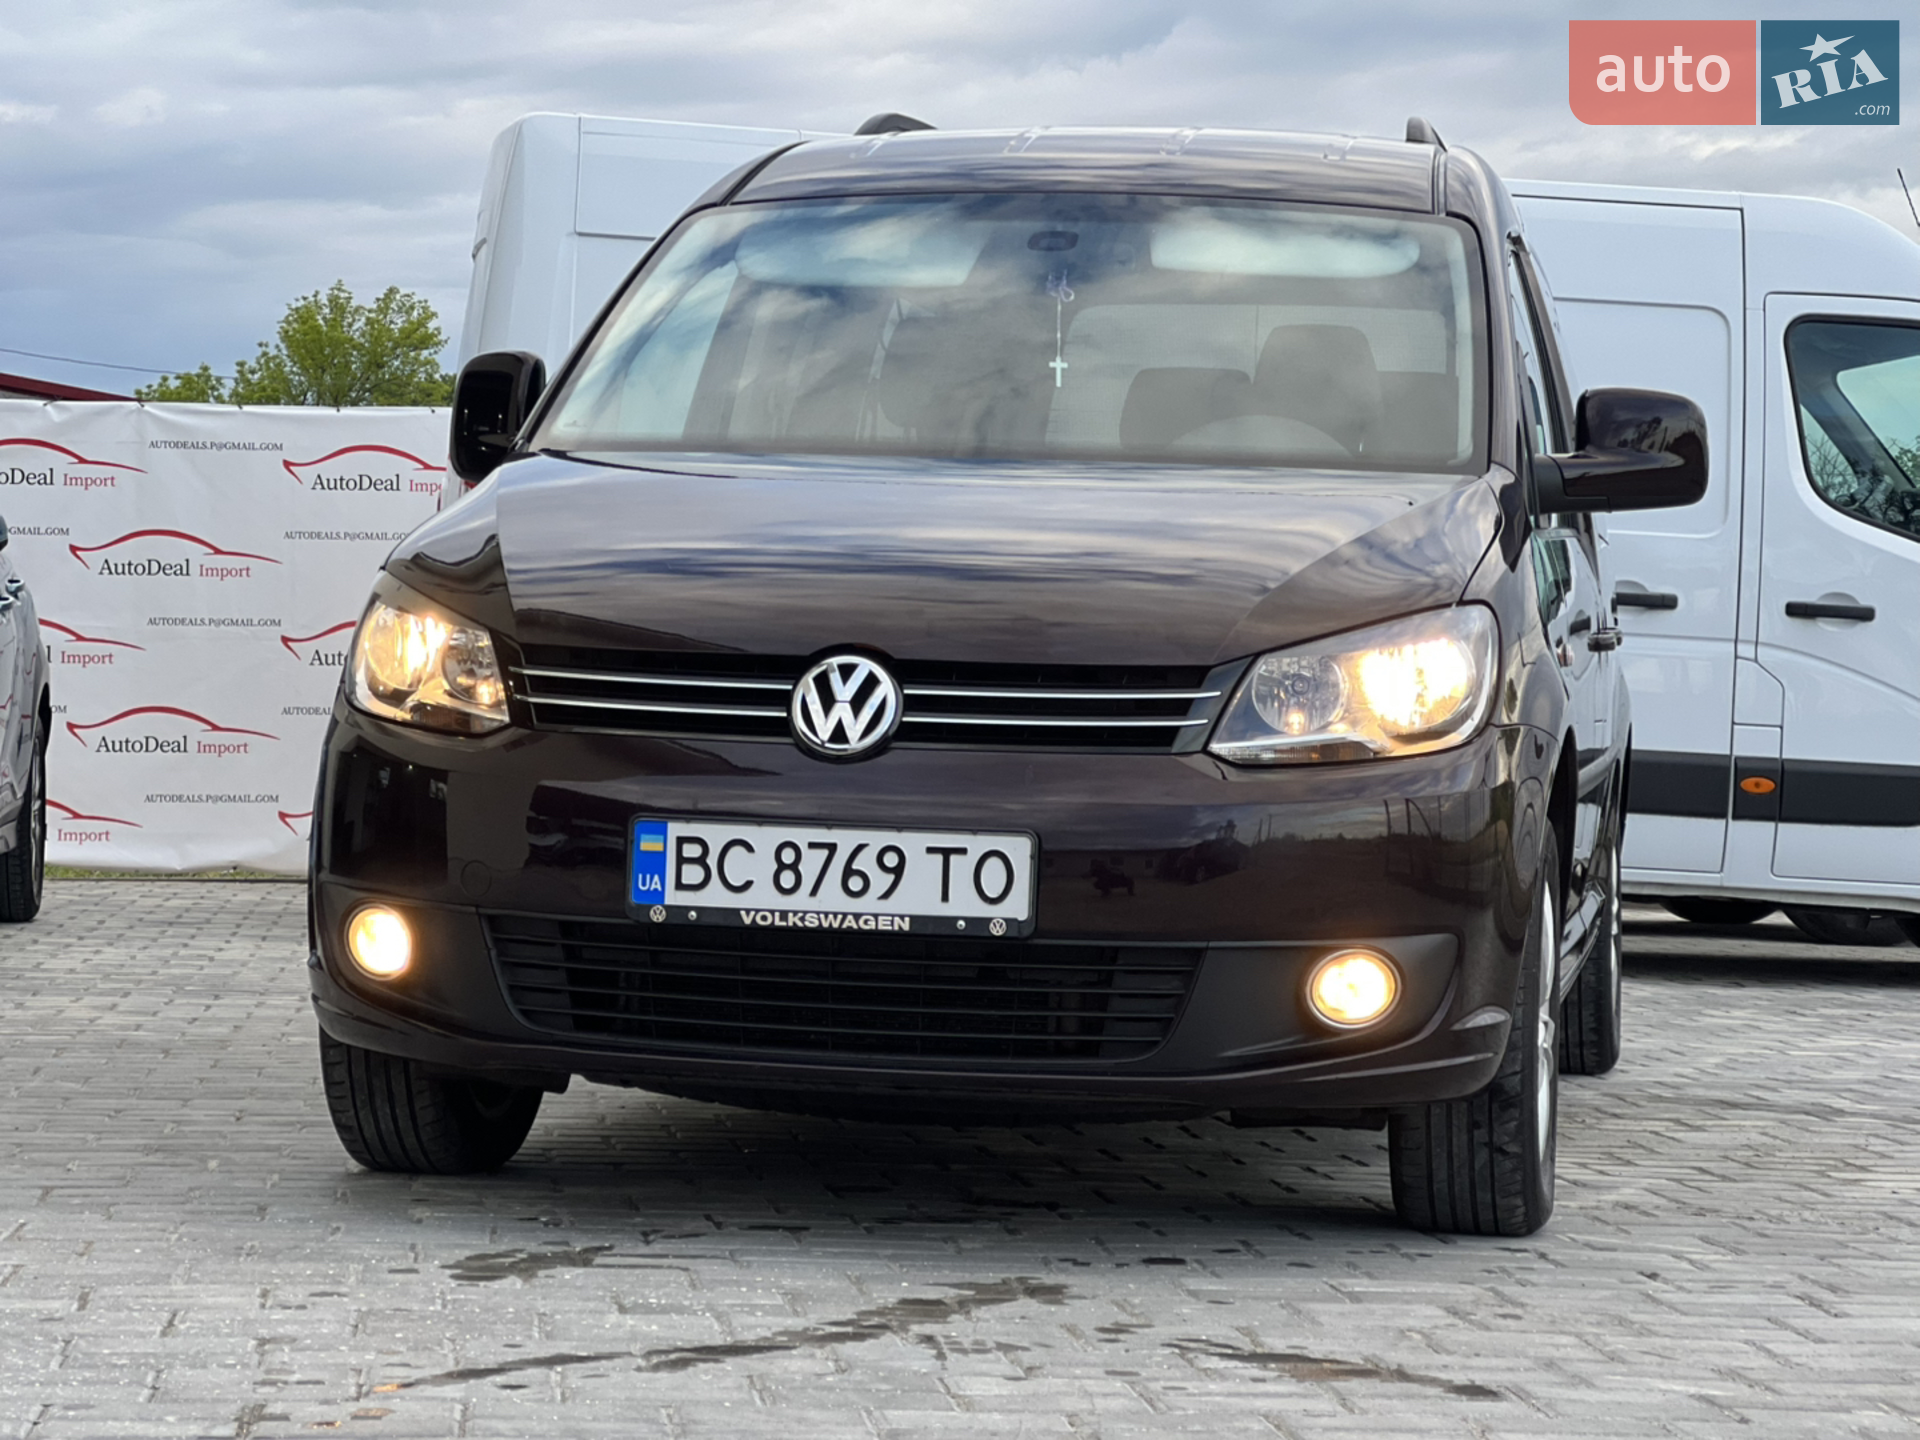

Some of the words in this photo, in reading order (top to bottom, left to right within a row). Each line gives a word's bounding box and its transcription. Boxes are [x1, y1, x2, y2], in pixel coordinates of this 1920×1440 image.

[0, 467, 55, 486] oDeal
[63, 473, 116, 491] Import
[311, 473, 401, 492] AutoDeal
[409, 479, 444, 497] Imp
[98, 558, 191, 577] AutoDeal
[198, 564, 251, 581] Import
[61, 650, 114, 668] Import
[95, 735, 188, 754] AutoDeal
[196, 741, 249, 758] Import
[57, 828, 111, 845] Import
[674, 835, 757, 894] BC
[772, 840, 908, 901] 8769
[925, 846, 1015, 906] TO
[638, 873, 663, 892] UA
[739, 909, 911, 932] VOLKSWAGEN
